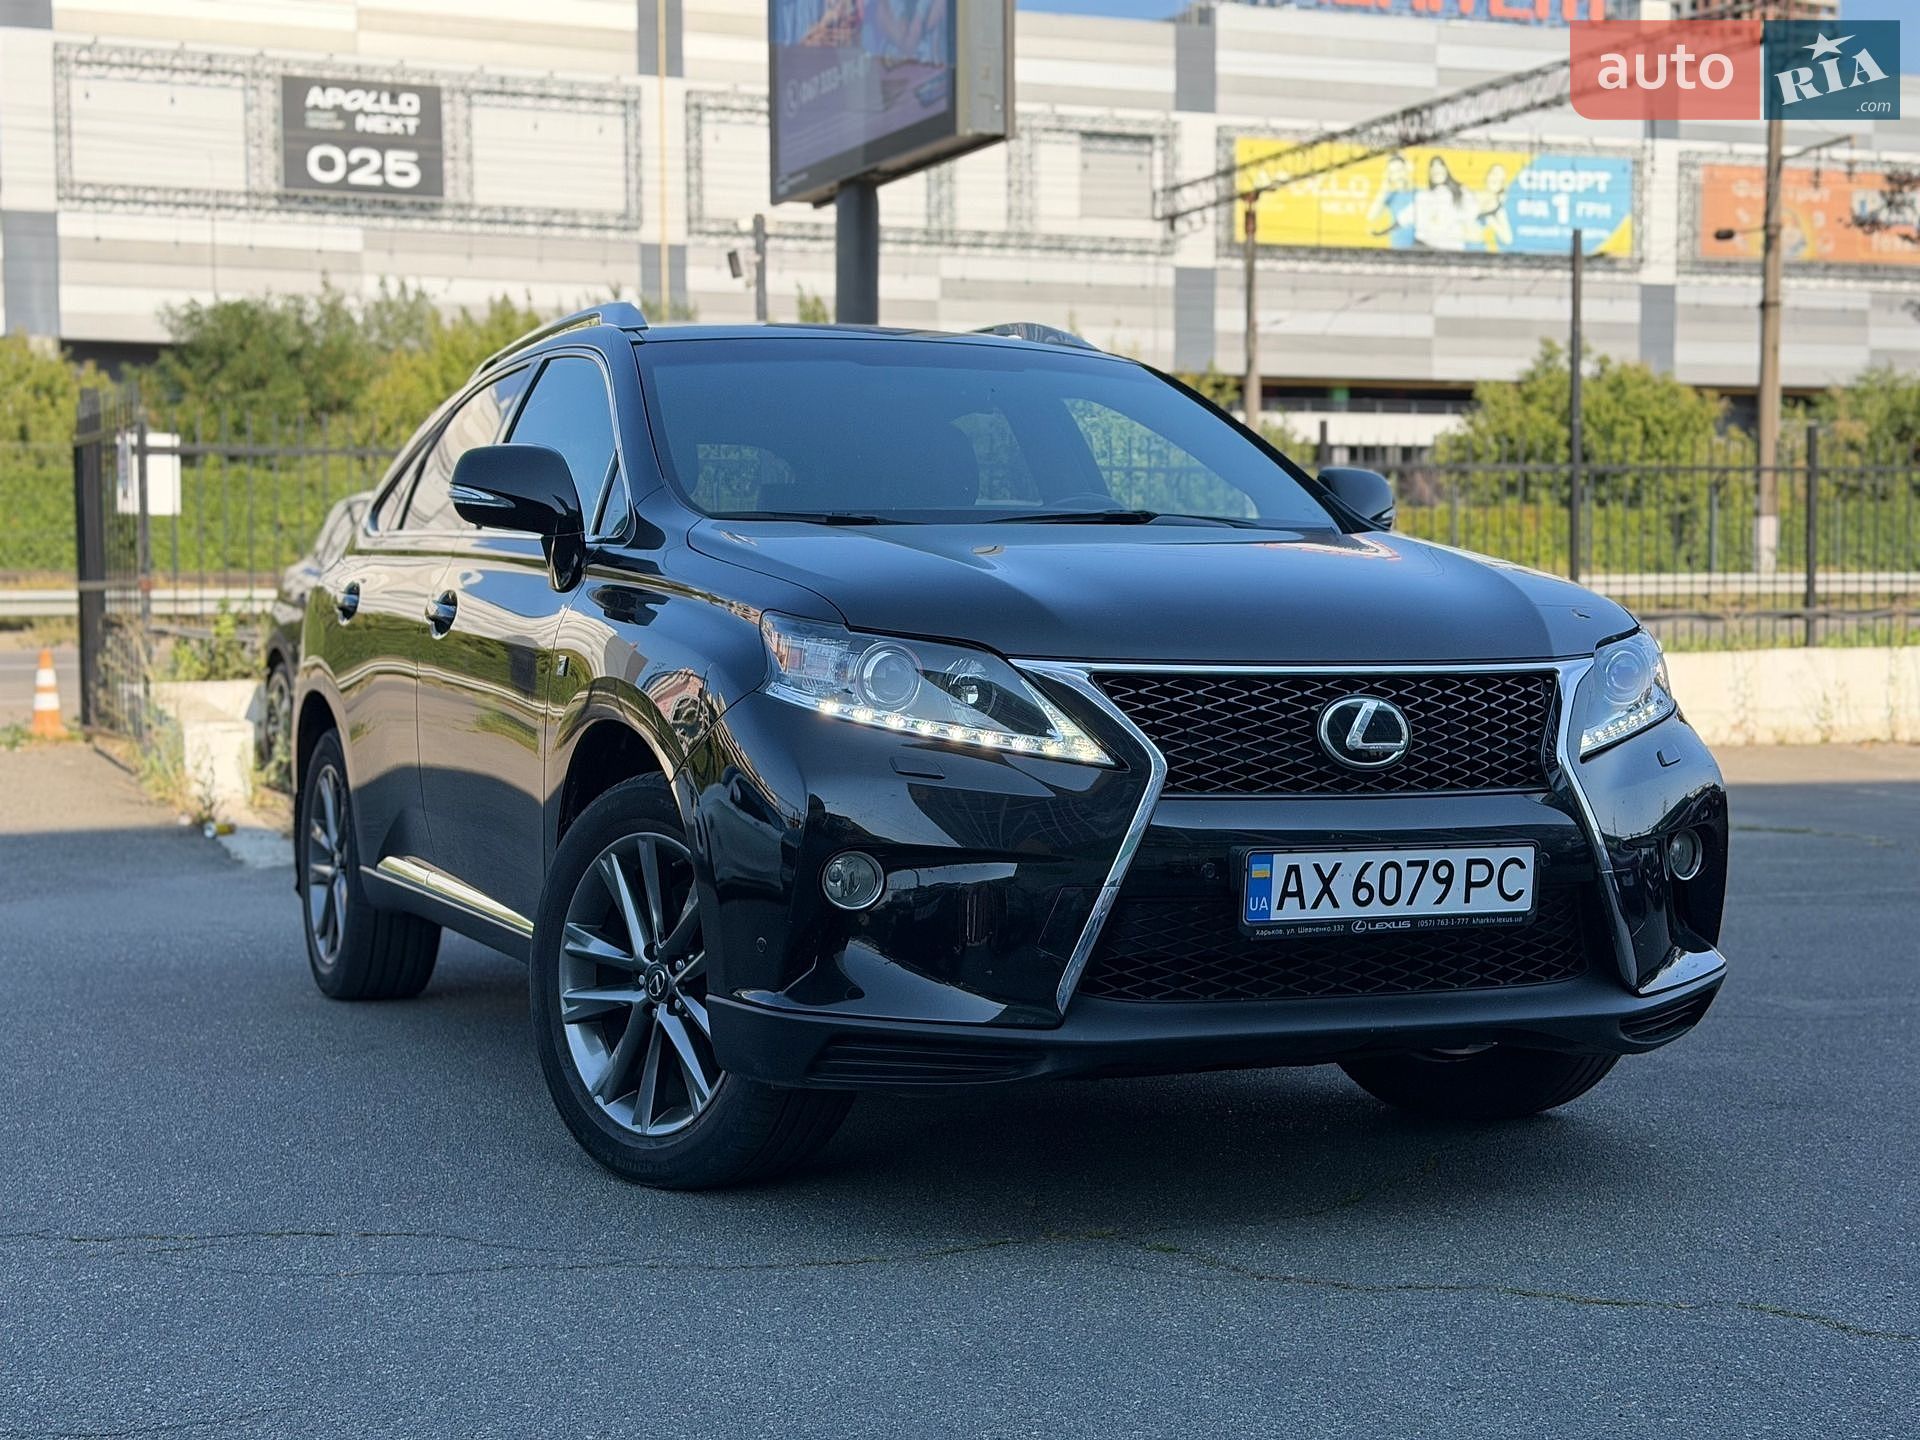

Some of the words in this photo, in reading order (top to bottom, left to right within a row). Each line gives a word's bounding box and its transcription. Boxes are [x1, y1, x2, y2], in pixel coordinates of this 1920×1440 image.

[304, 84, 421, 116] APOLLO
[355, 112, 421, 136] NEXT
[306, 144, 422, 188] 025
[1518, 169, 1612, 193] СПОРТ
[1552, 192, 1569, 225] 1
[1276, 861, 1343, 911] AX
[1352, 859, 1455, 908] 6079
[1463, 856, 1526, 905] PC
[1249, 896, 1269, 911] UA
[1368, 920, 1411, 931] LEXUS
